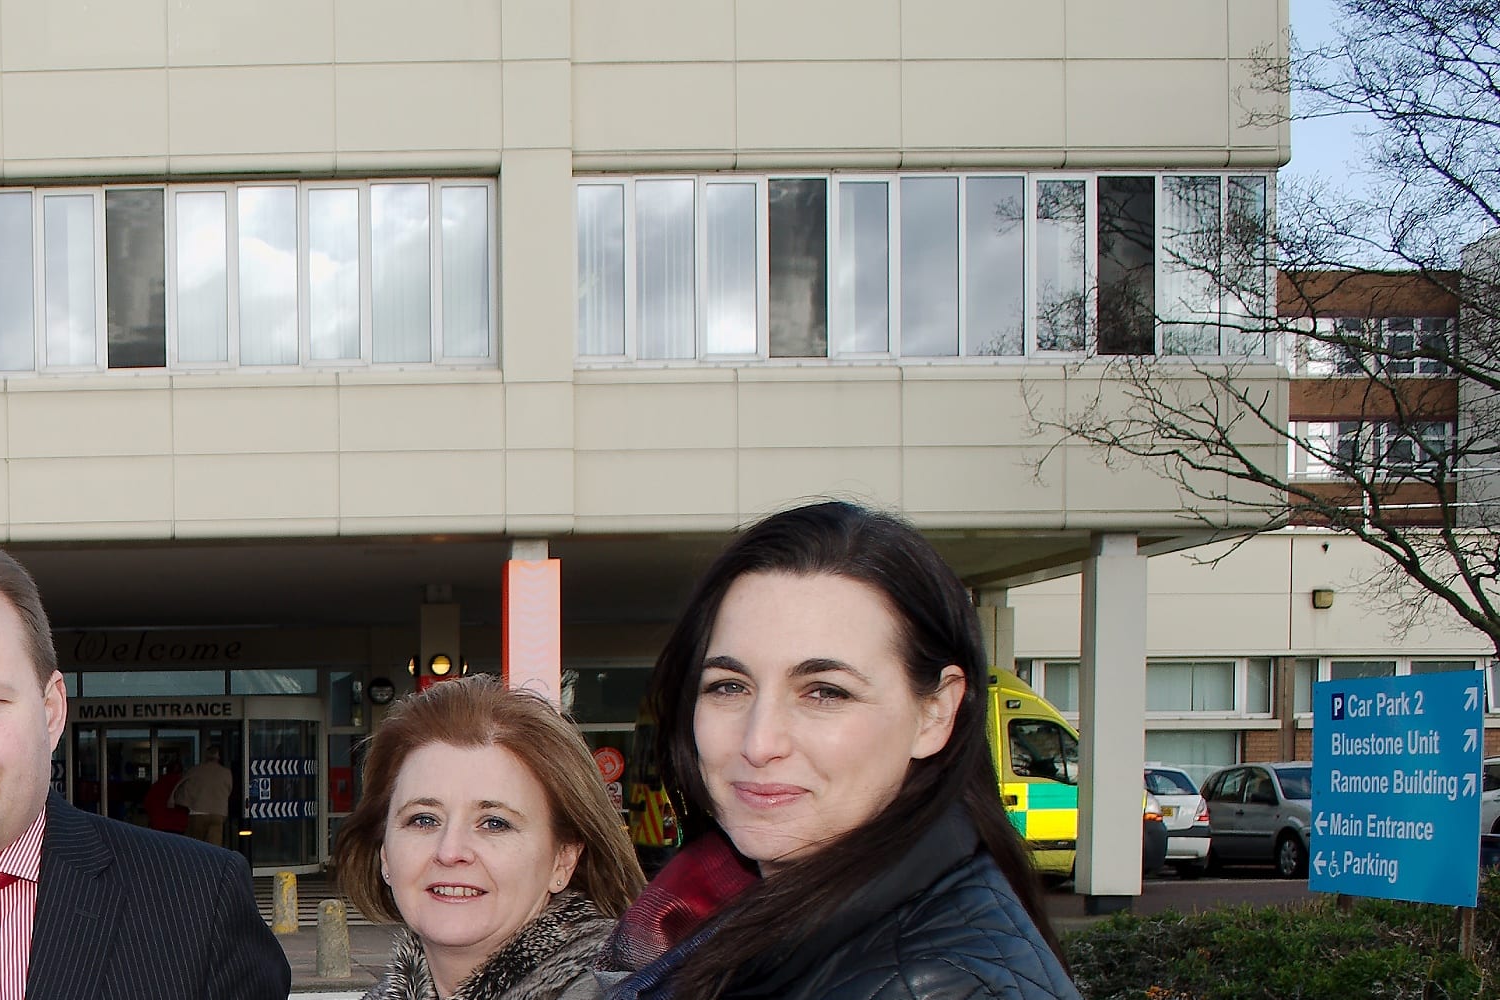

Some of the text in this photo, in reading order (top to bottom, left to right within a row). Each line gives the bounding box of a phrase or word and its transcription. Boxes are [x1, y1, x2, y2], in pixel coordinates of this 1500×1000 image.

[73, 629, 242, 662] Welcome
[79, 702, 233, 719] MAIN ENTRANCE
[1333, 690, 1424, 718] P Car Park 2
[1331, 730, 1441, 756] Bluestone Unit
[1330, 769, 1458, 801] Ramone Building
[1329, 812, 1434, 840] Main Entrance
[1343, 851, 1398, 883] Parking
